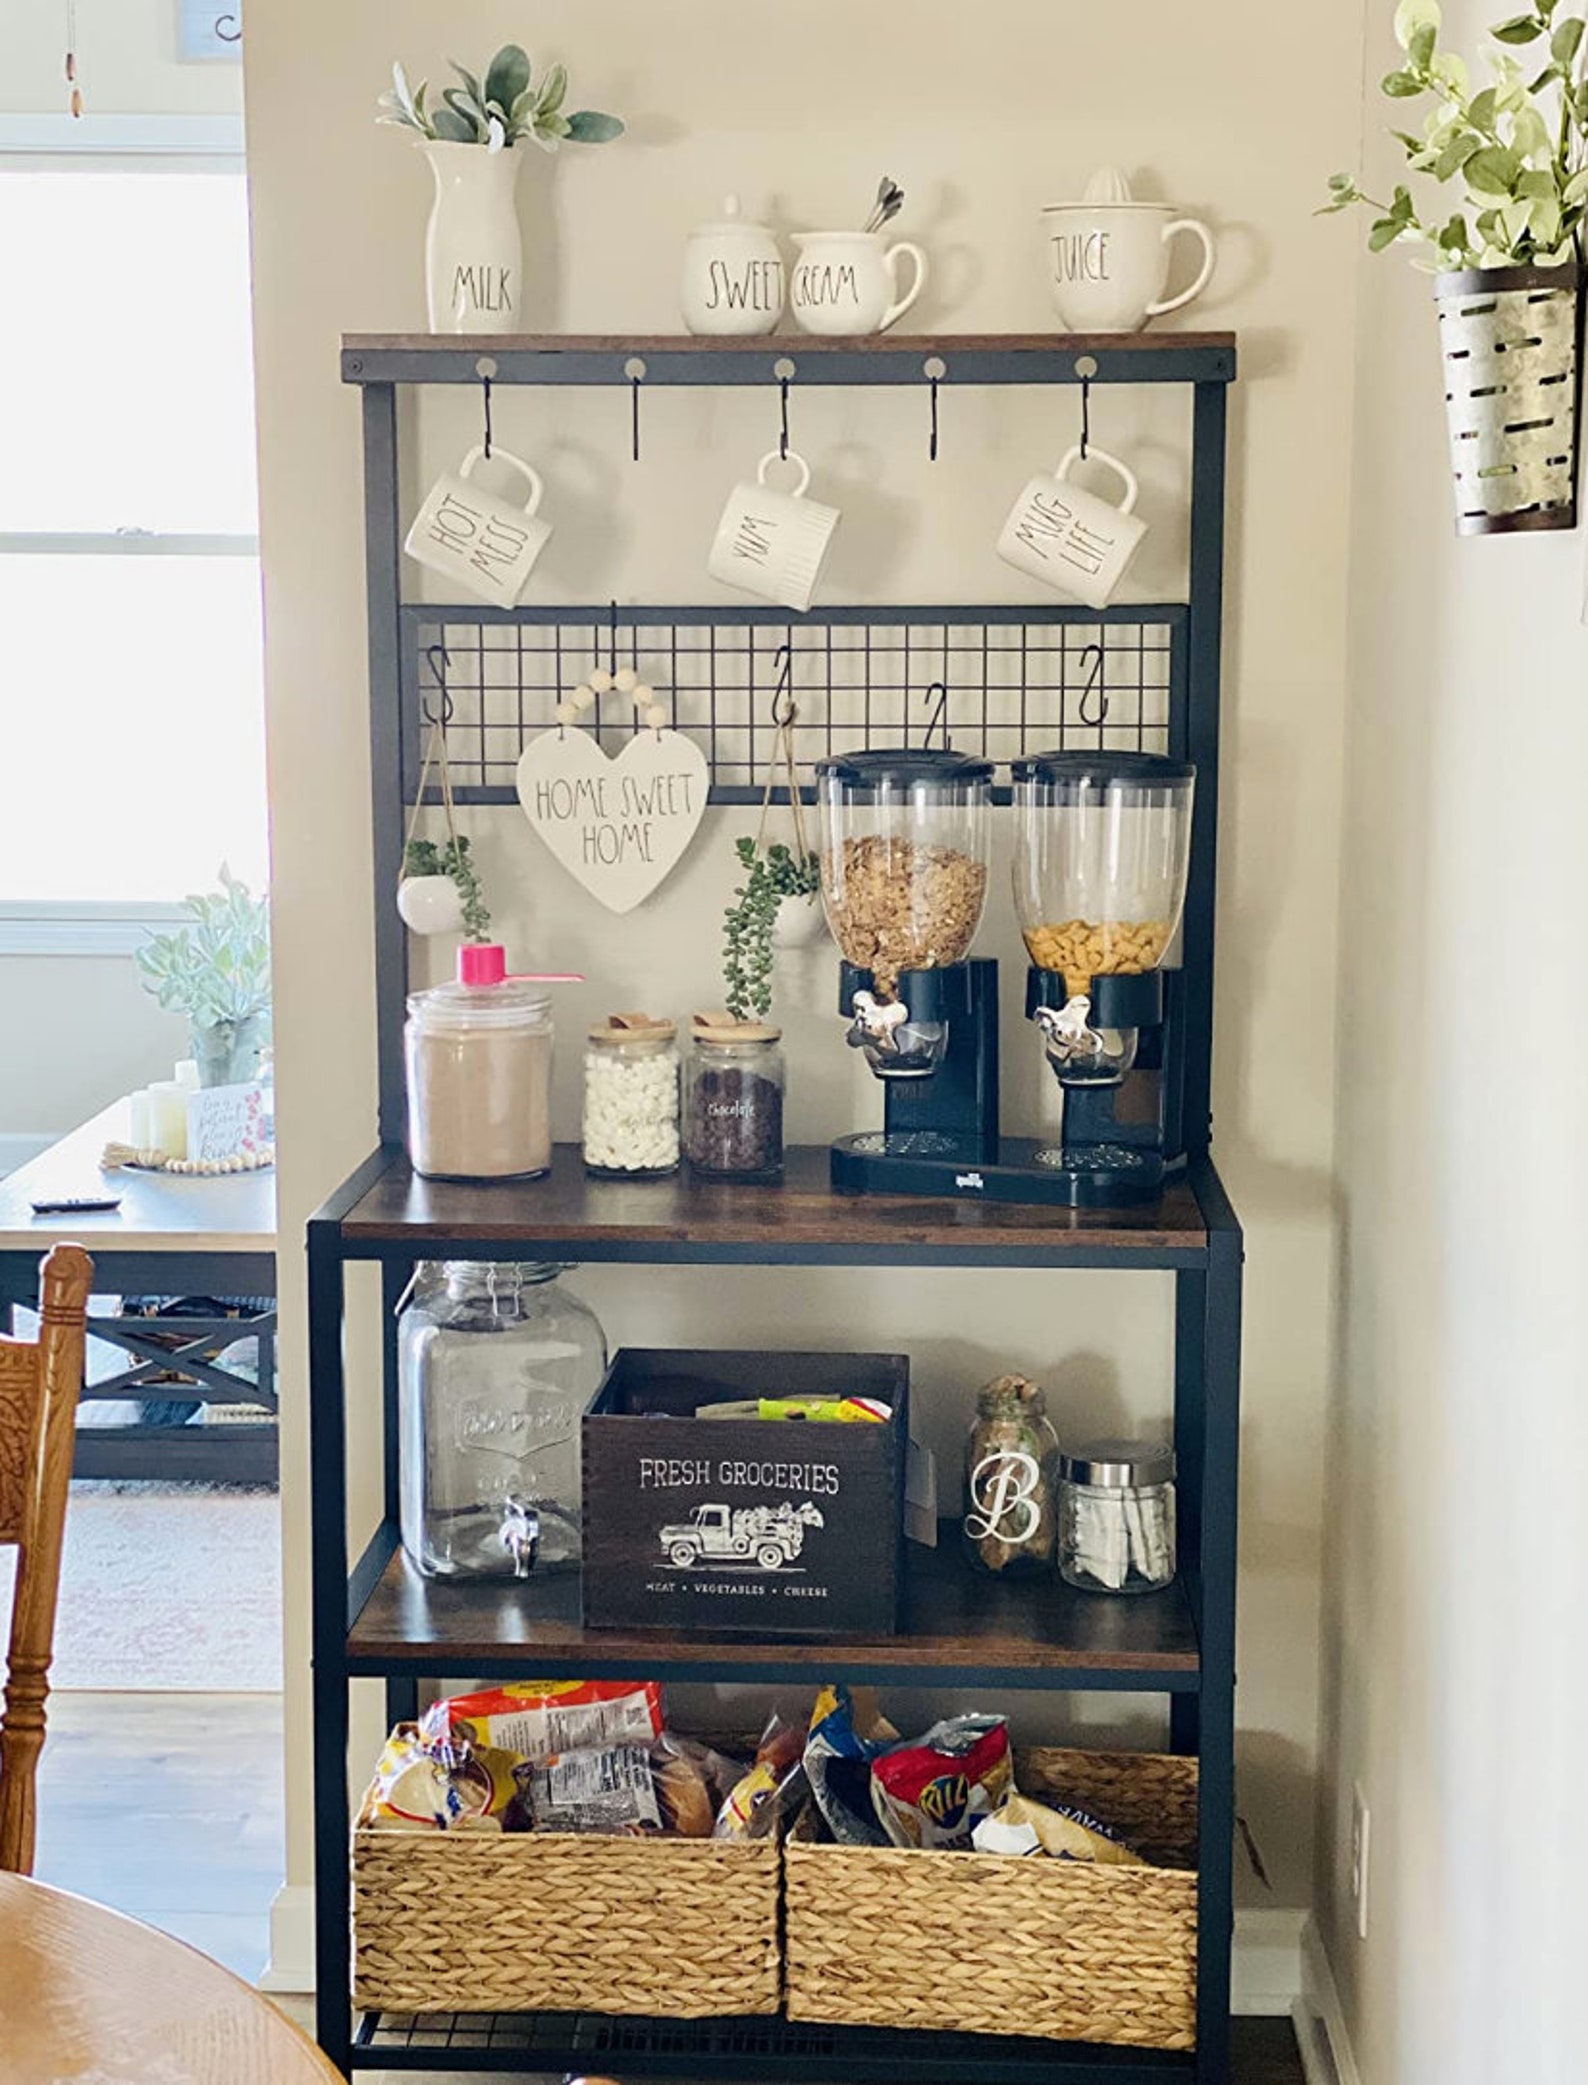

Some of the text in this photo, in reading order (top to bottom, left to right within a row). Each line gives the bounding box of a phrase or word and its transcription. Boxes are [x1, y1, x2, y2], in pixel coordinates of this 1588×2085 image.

[1050, 232, 1111, 284] JUICE
[451, 265, 512, 312] MILK
[706, 260, 782, 311] SWEET
[794, 264, 860, 308] CREAM
[428, 492, 483, 555] HOT
[732, 515, 779, 568] YUM
[1015, 491, 1073, 560] MUG
[1058, 519, 1116, 576] LIFE
[469, 514, 530, 586] MESS
[535, 773, 694, 821] HOME SWEET
[582, 822, 655, 865] HOME
[639, 1457, 841, 1496] FRESH GROCERIES
[964, 1451, 1042, 1544] B
[645, 1582, 829, 1598] MEAT VEGETABLES CHEESE
